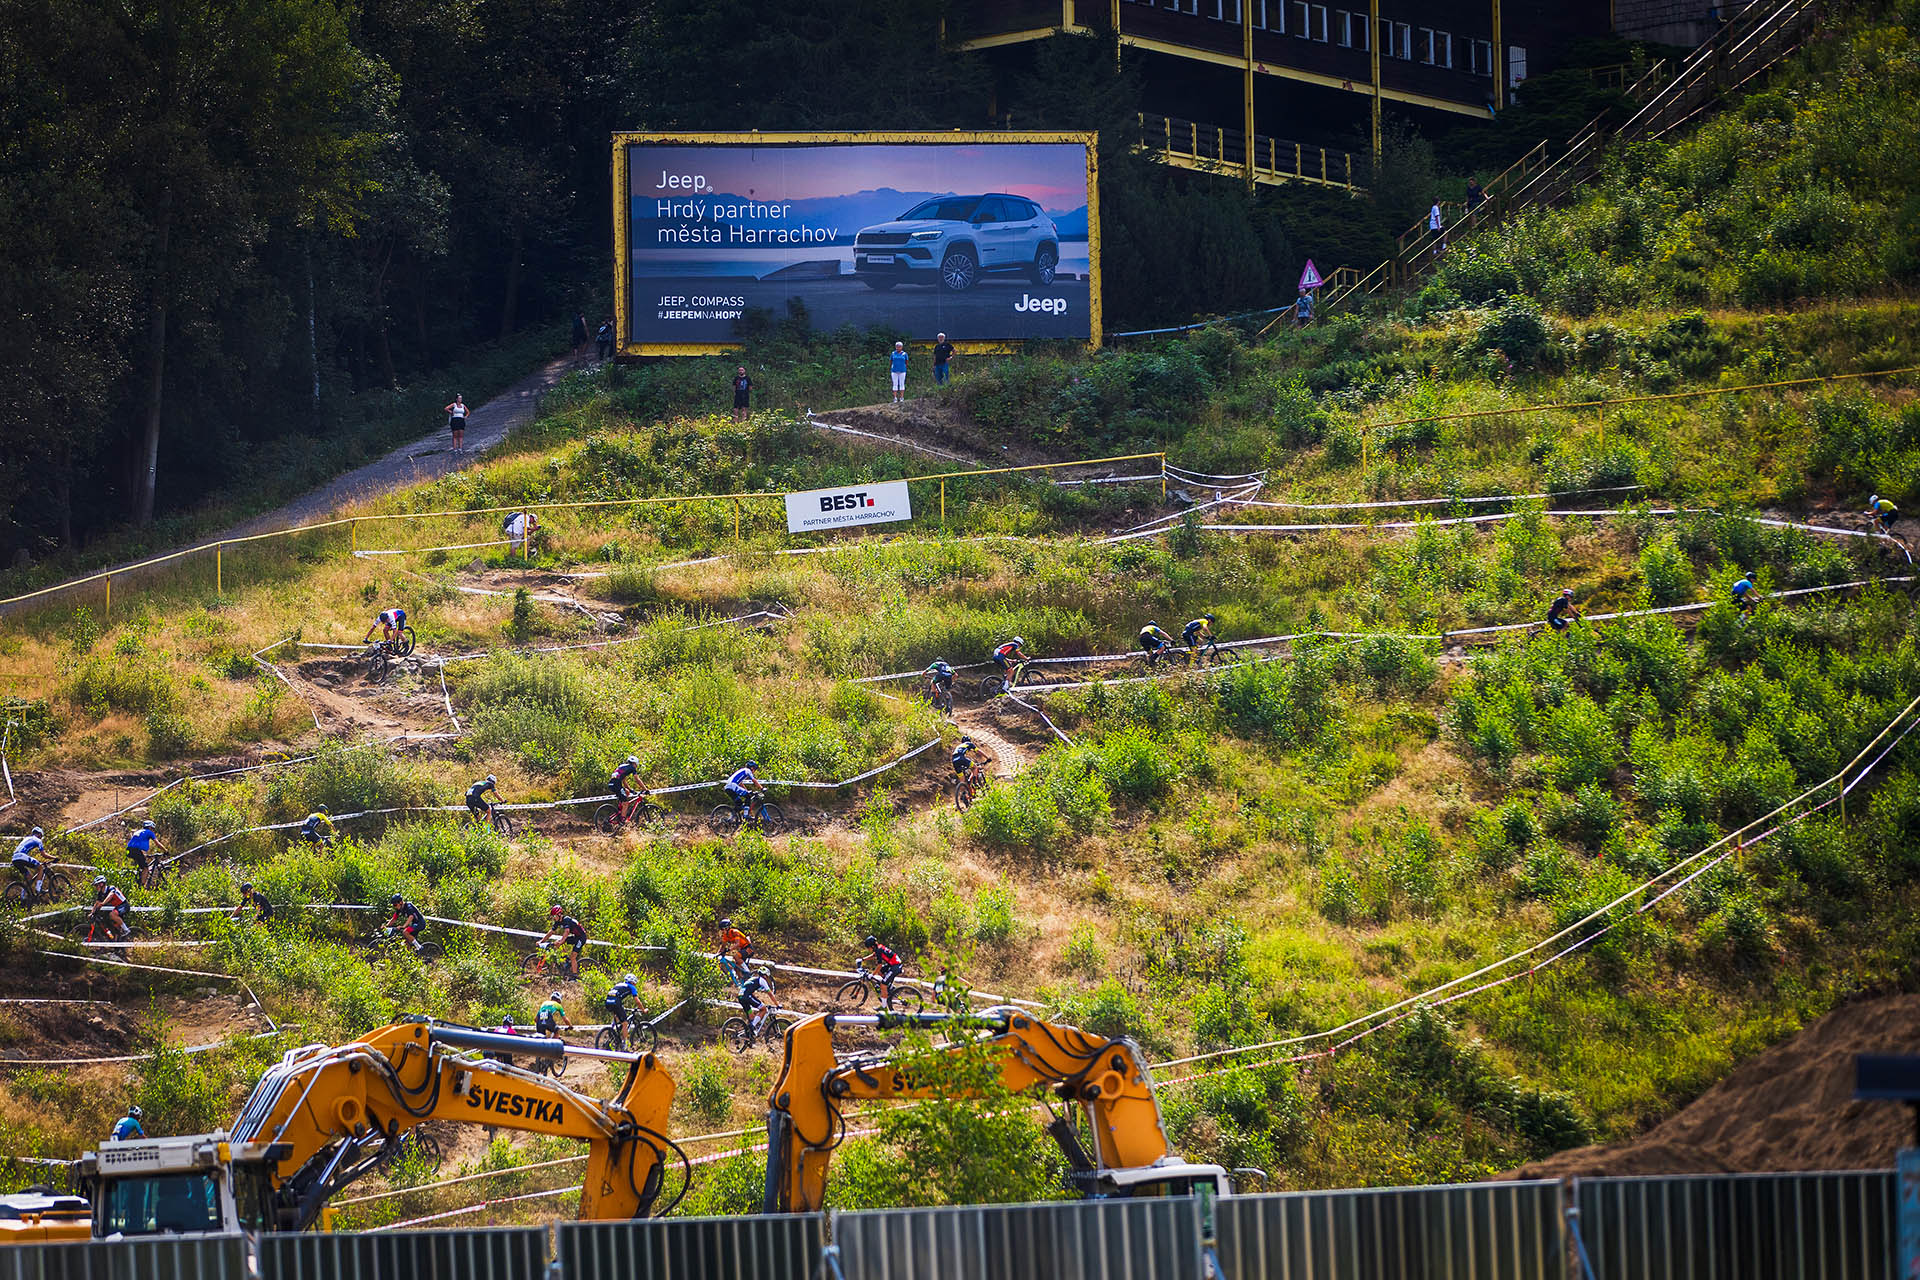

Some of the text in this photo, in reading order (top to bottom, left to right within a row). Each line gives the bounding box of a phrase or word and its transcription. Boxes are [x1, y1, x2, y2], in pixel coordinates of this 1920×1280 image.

[657, 199, 791, 222] Hrdý partner
[658, 224, 838, 243] města Harrachov
[691, 296, 745, 306] COMPASS
[1014, 294, 1067, 315] Jeep
[658, 310, 743, 319] #JEEPEMNAHORY
[803, 517, 832, 526] PARTNER
[855, 510, 896, 520] HARRACHOV
[466, 1084, 564, 1124] ŠVESTKA
